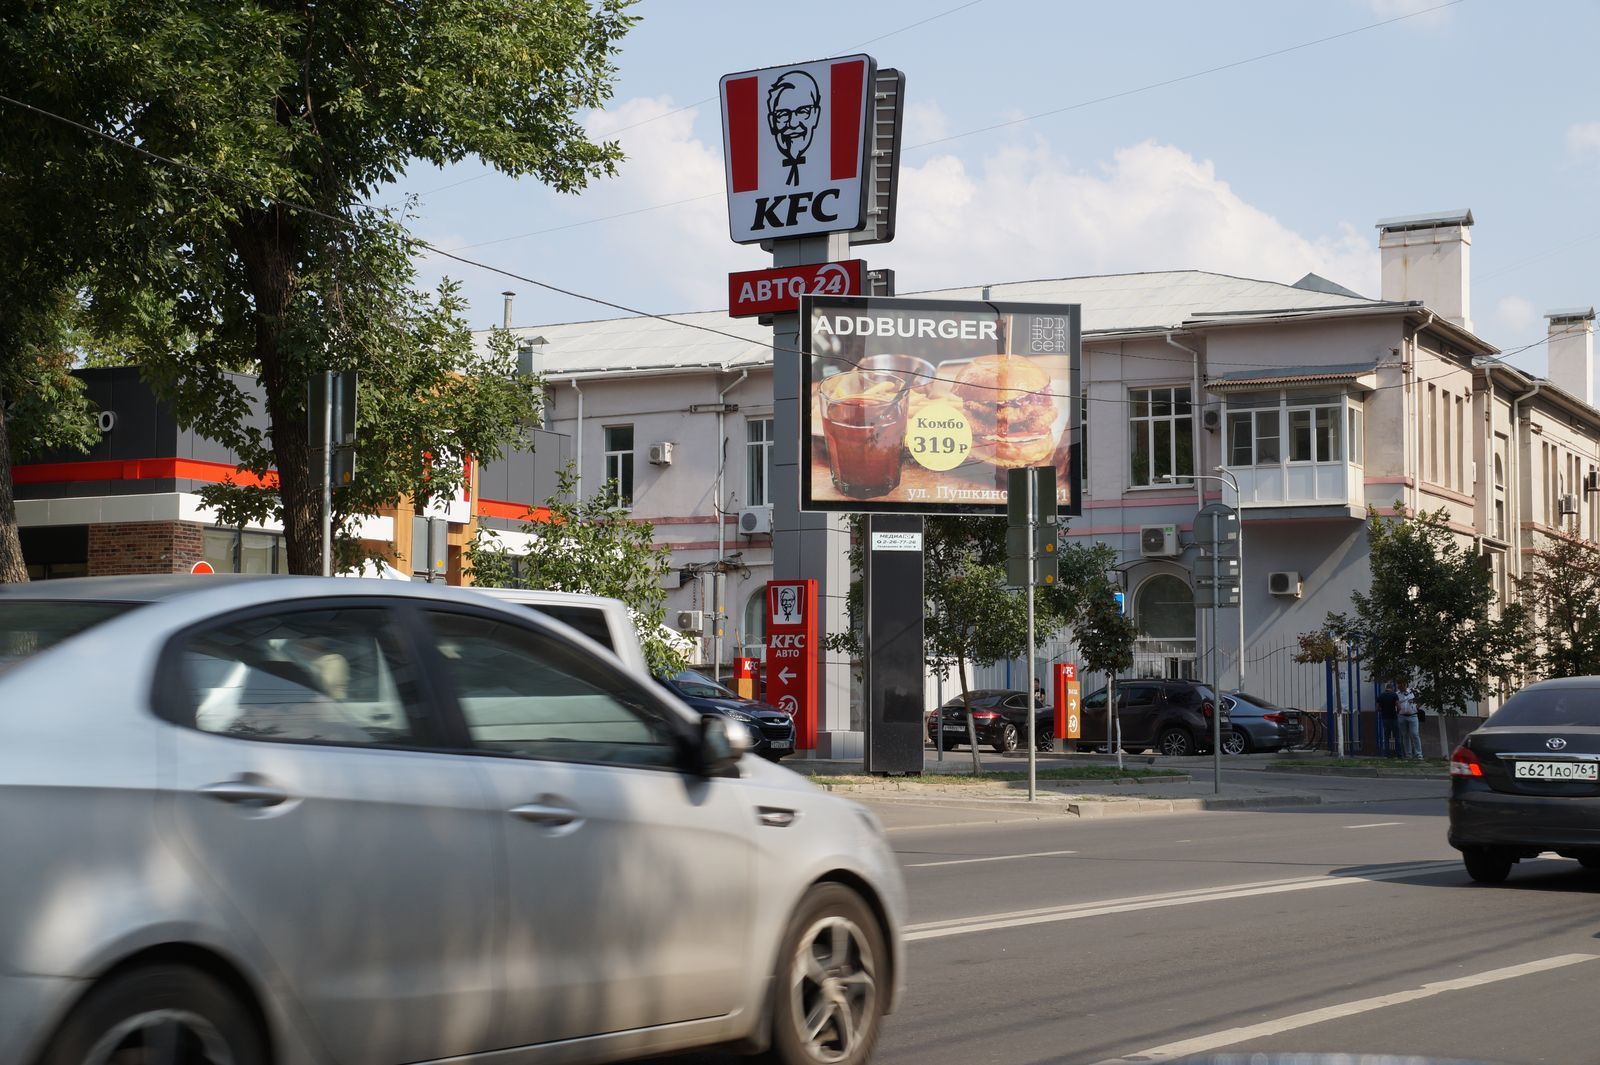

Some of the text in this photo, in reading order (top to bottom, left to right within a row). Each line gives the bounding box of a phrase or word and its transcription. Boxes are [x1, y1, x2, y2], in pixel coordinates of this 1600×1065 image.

[750, 188, 840, 231] KFC
[738, 274, 842, 304] АВТО 24
[813, 315, 999, 341] ADDBURGER
[1031, 328, 1066, 340] BUR
[917, 417, 964, 430] Комбо
[913, 436, 956, 454] 319
[907, 488, 931, 502] ул.
[936, 485, 1008, 502] Пушкинс
[769, 634, 806, 649] KFC
[775, 649, 800, 658] АВТО
[743, 660, 759, 671] KFC
[1519, 763, 1596, 777] С621АО 761
